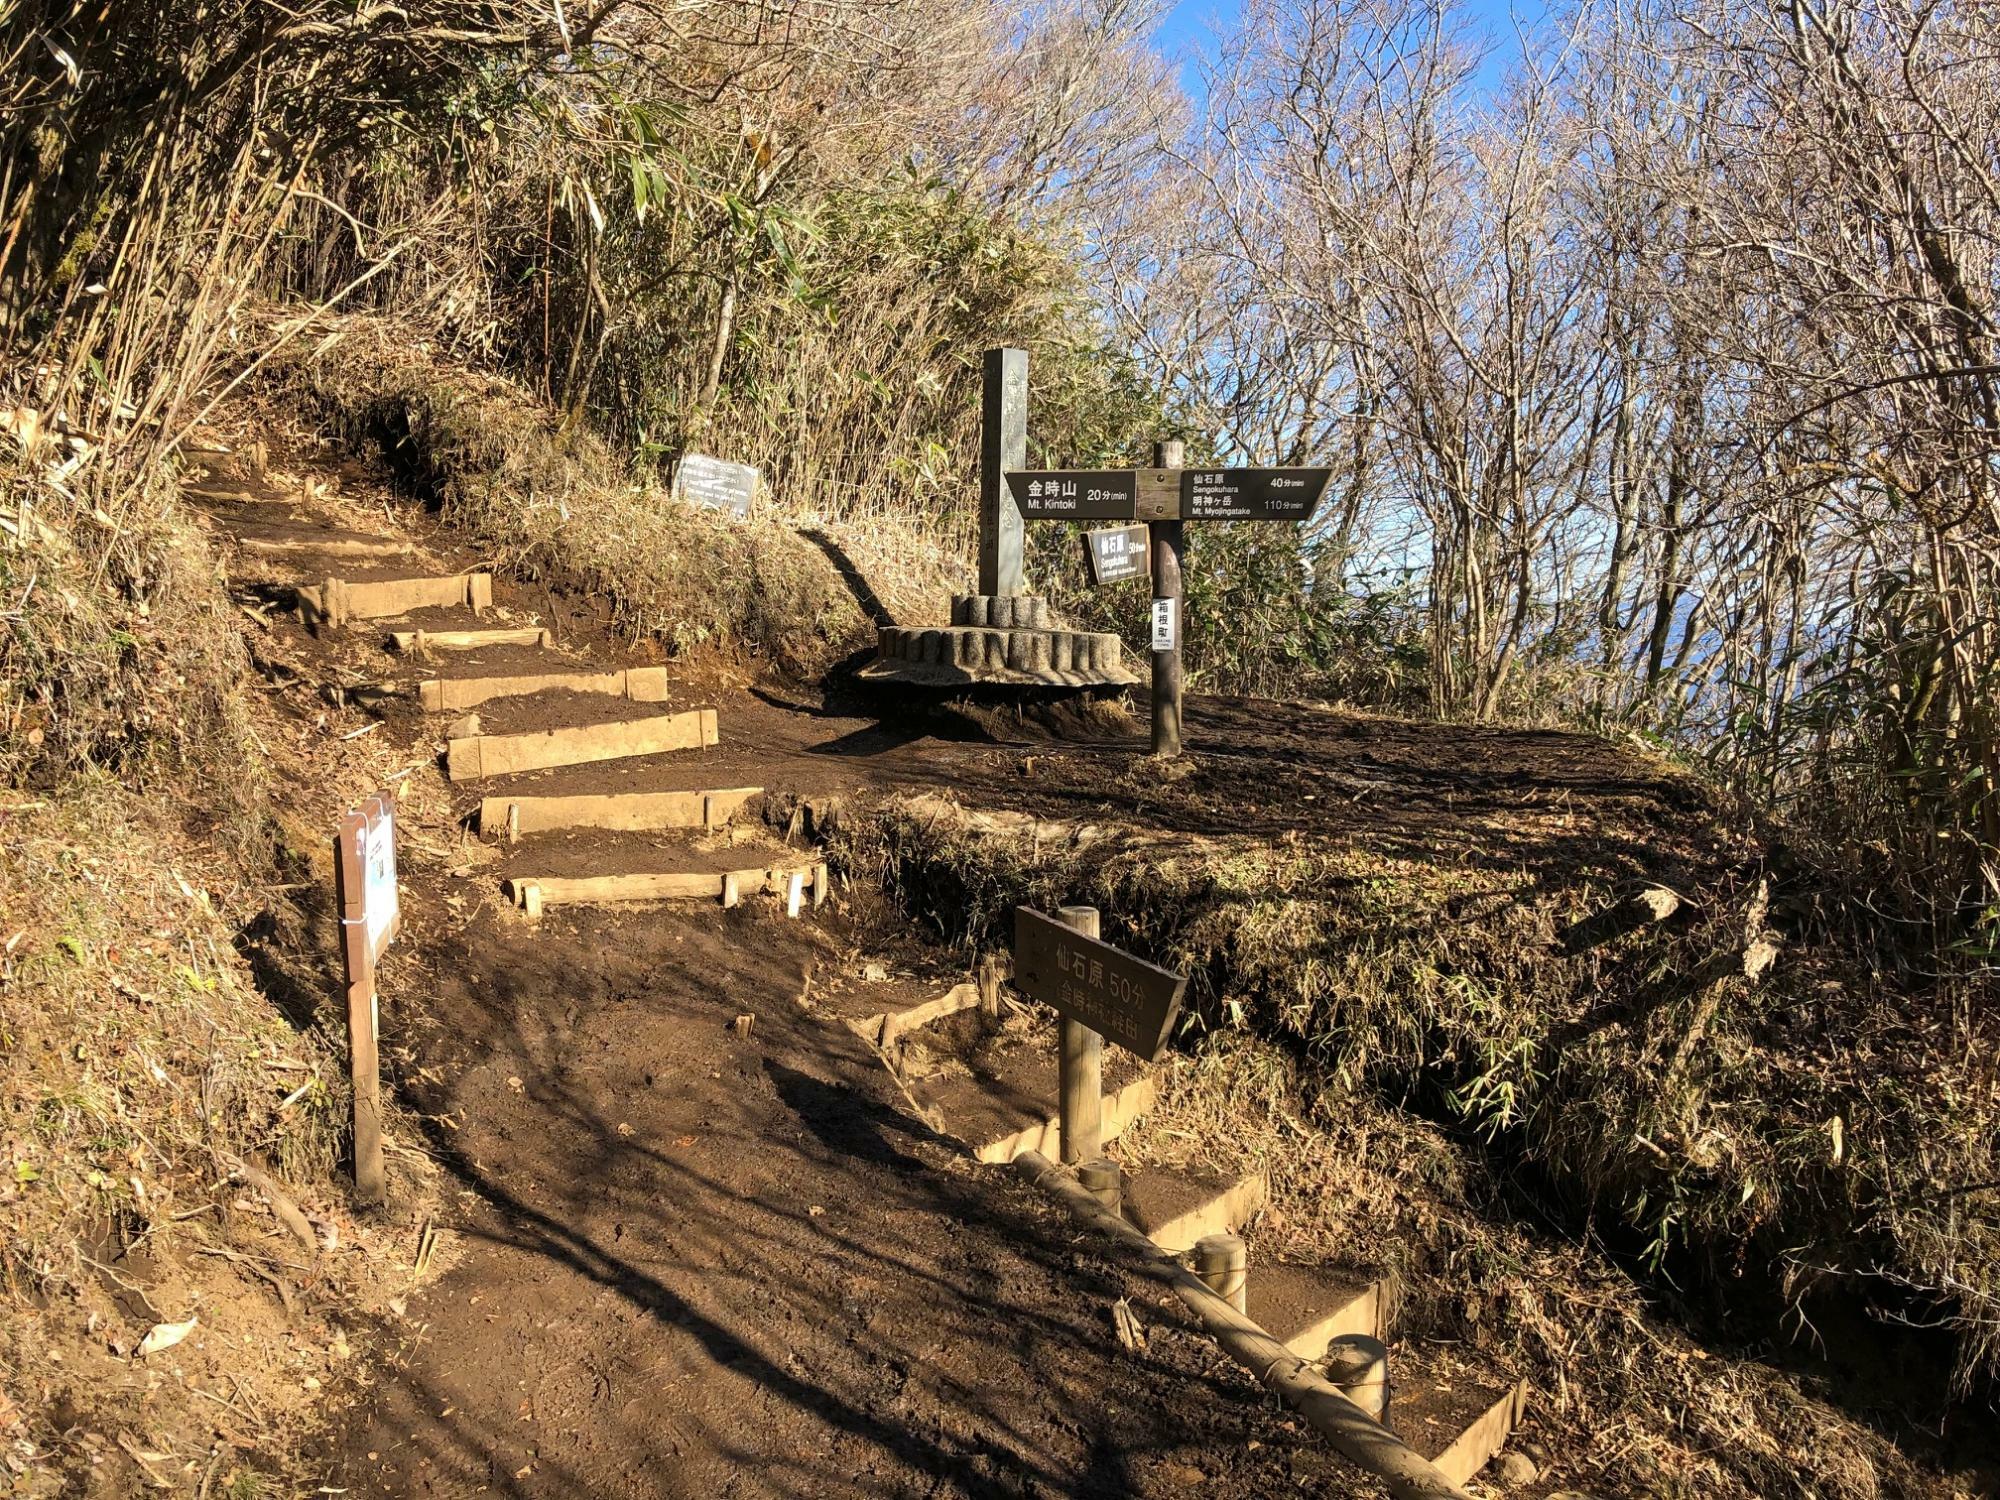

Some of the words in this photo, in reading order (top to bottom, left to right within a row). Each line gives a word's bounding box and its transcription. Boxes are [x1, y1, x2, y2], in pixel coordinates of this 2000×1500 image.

[1192, 473, 1225, 485] 仙石原
[1027, 480, 1077, 497] 金時山
[1192, 485, 1239, 494] Sengokuhara
[1087, 489, 1128, 501] 20分(min)
[1028, 499, 1042, 510] Mt.
[1044, 499, 1077, 510] Kintoki
[1192, 507, 1203, 516] Mt.
[1204, 507, 1251, 516] Myojingatake
[1158, 602, 1169, 638] 箱根町
[1056, 944, 1104, 990] 仙石原
[1109, 972, 1146, 1010] 50分
